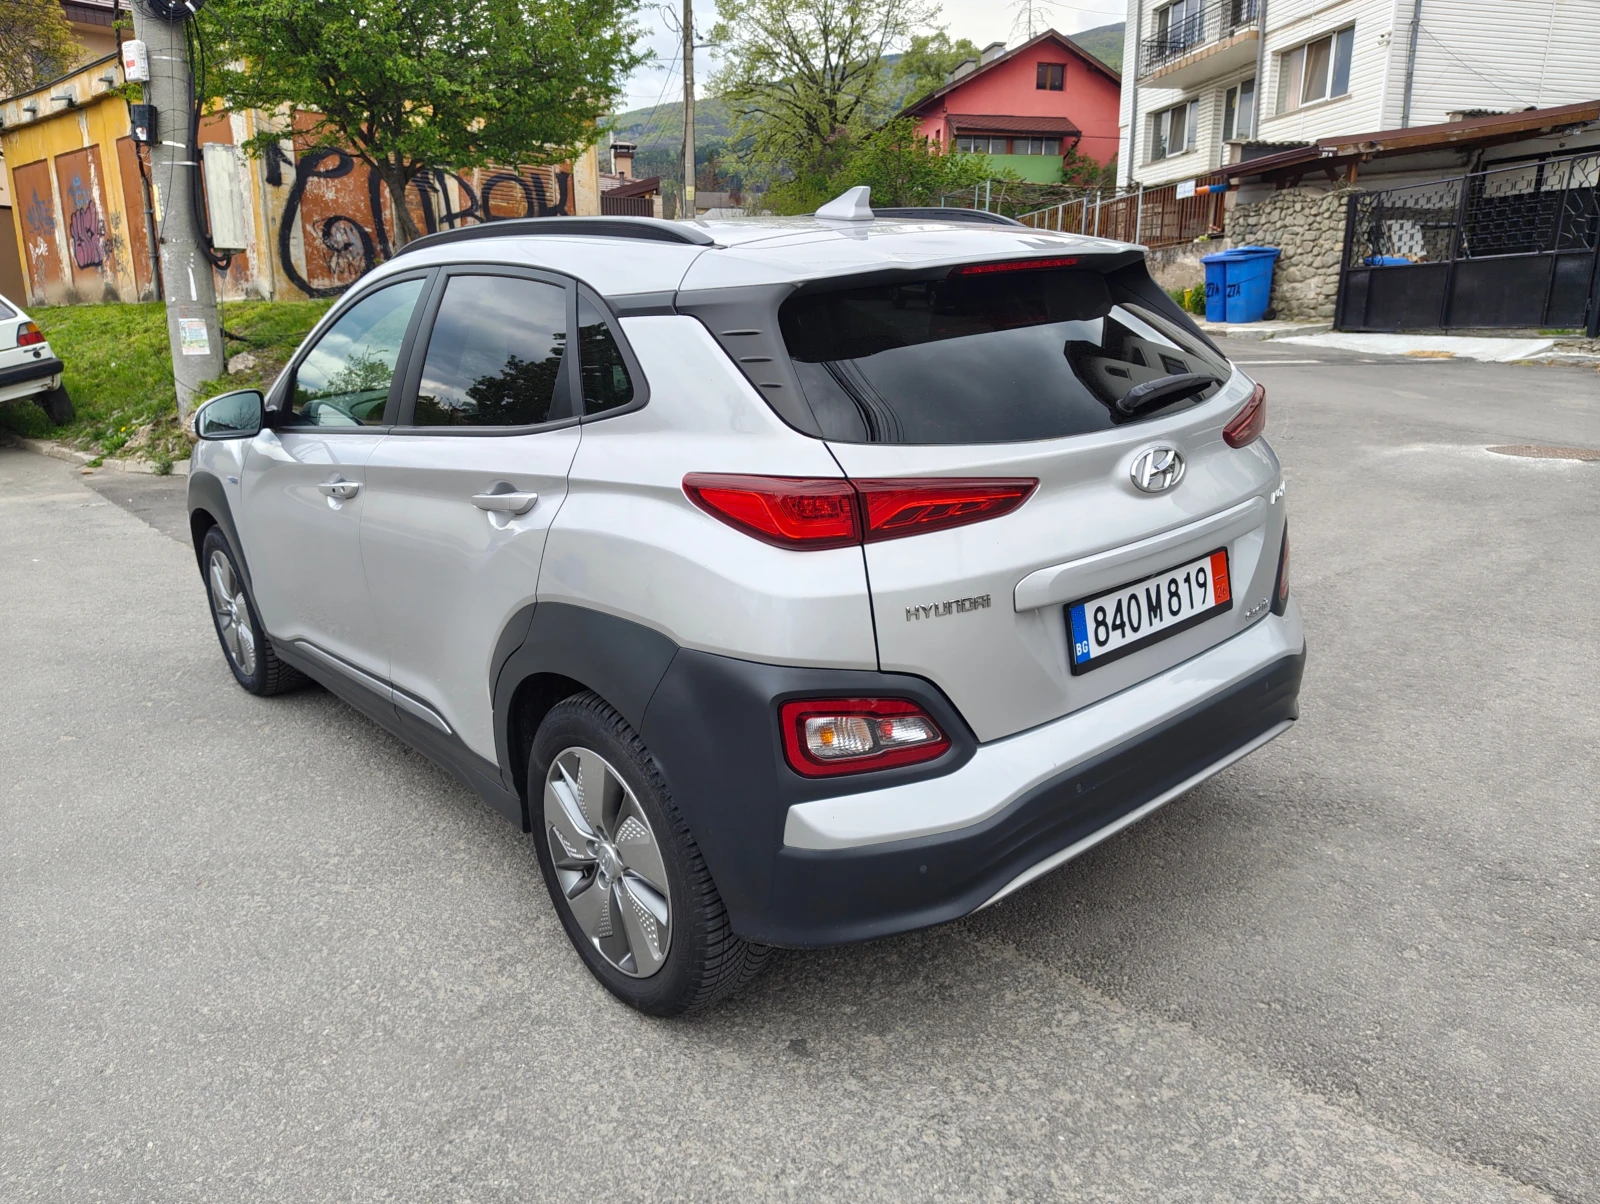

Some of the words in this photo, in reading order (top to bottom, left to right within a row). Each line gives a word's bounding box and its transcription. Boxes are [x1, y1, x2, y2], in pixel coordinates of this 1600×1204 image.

[1206, 282, 1220, 298] 27A
[1226, 283, 1241, 298] 27A
[905, 593, 992, 622] HYUNDAI
[1075, 641, 1089, 656] BG
